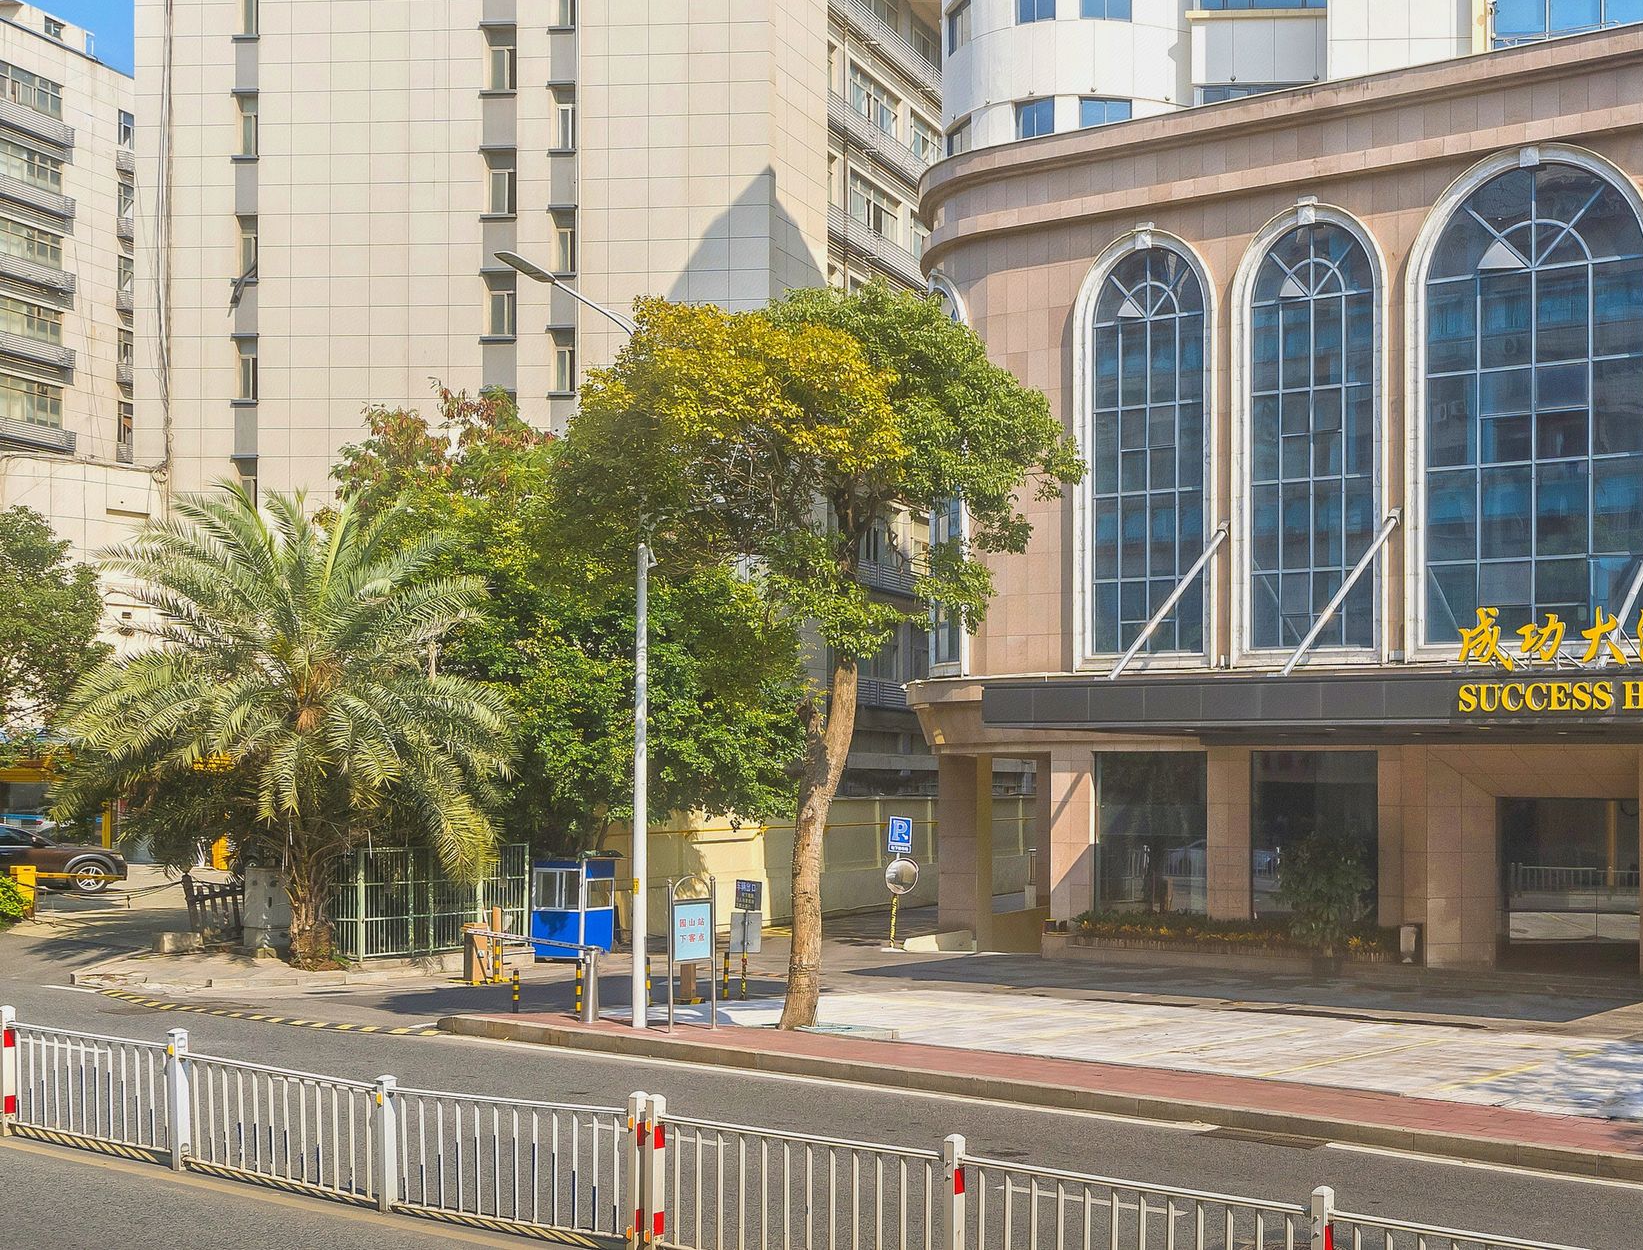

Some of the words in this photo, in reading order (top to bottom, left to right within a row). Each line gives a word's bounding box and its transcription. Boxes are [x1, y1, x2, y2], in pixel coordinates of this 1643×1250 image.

[1458, 680, 1613, 713] SUCCESS
[679, 933, 704, 943] 下客点
